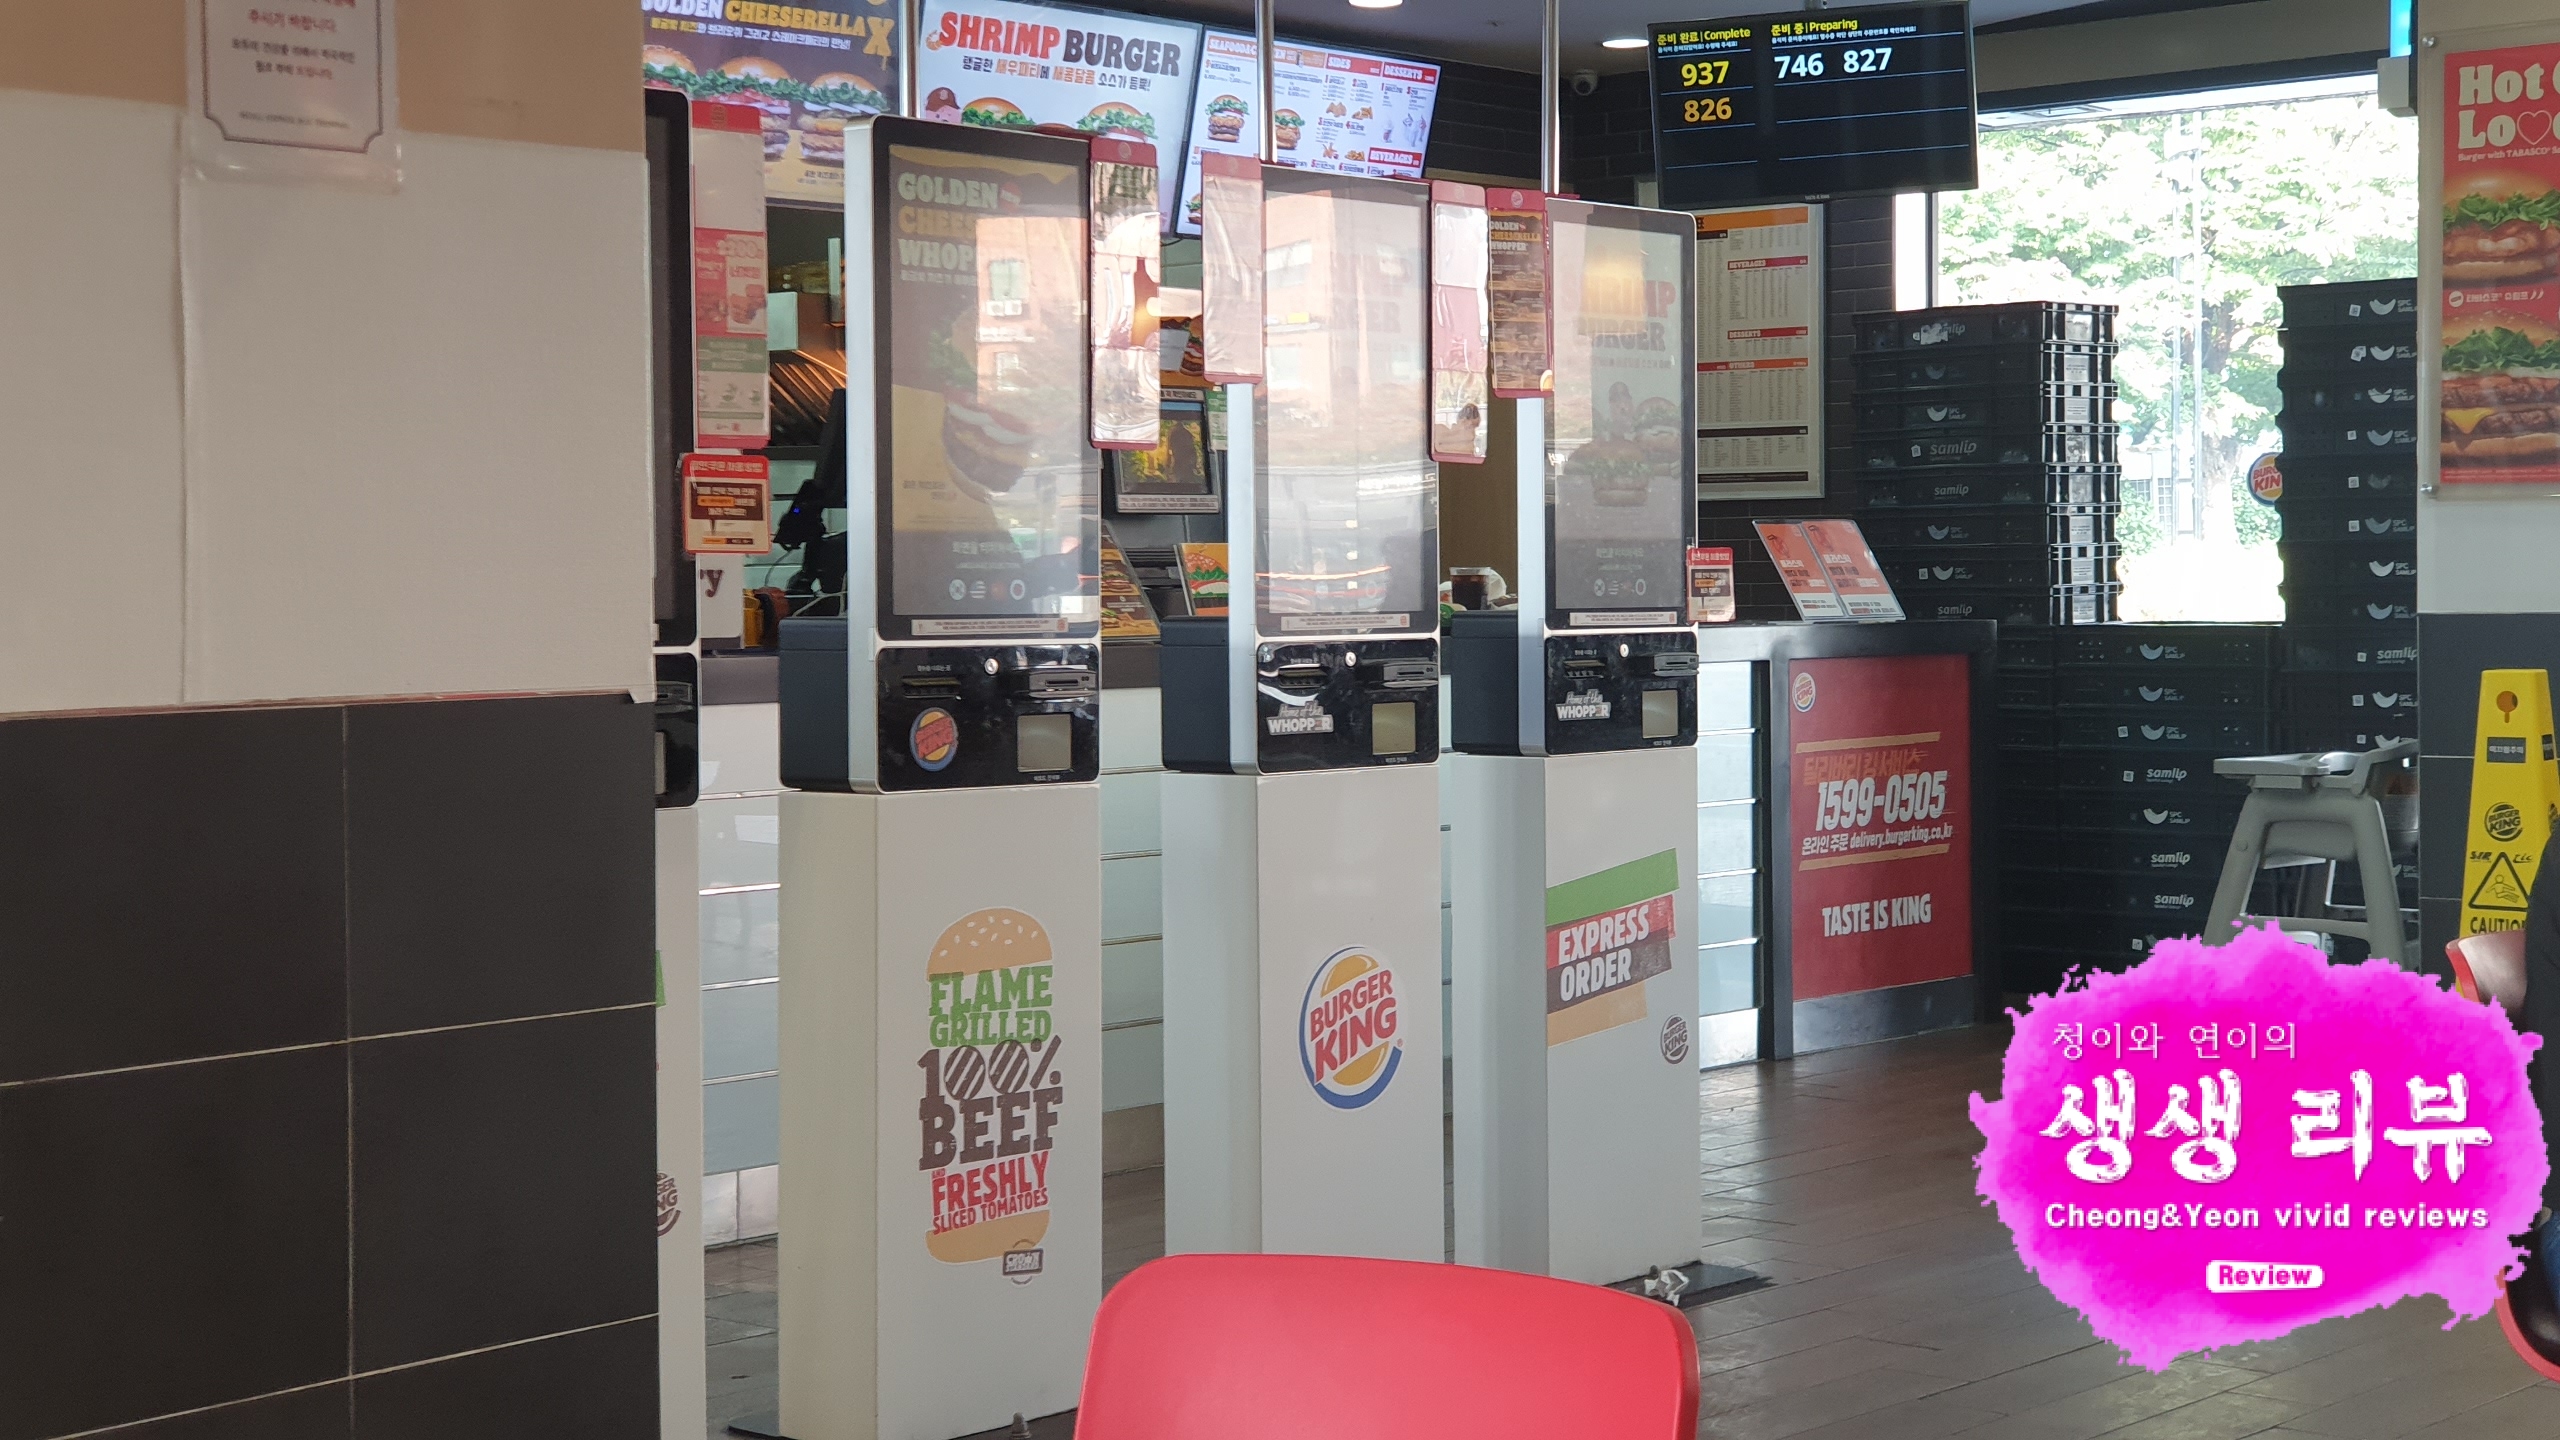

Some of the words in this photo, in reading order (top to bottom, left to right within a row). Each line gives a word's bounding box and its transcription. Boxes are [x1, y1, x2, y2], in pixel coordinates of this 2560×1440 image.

[725, 1, 866, 37] CHEESERELLA
[863, 17, 895, 56] X
[1657, 33, 1677, 46] 준비
[1679, 31, 1700, 45] 완료
[1704, 28, 1751, 41] Complete
[1771, 24, 1790, 36] 준비
[1793, 22, 1804, 34] 중
[1809, 19, 1858, 33] Preparing
[939, 11, 1061, 60] SHRIMP
[1063, 29, 1183, 77] BURGER
[995, 58, 1050, 80] 새우패티에
[1052, 65, 1095, 85] 새콤달콤
[1097, 73, 1127, 89] 소스가
[1680, 60, 1730, 87] 937
[1774, 53, 1825, 79] 746
[1843, 47, 1893, 75] 827
[2458, 62, 2545, 106] Hot
[1684, 97, 1732, 123] 826
[2458, 152, 2486, 163] Burger
[2487, 151, 2505, 160] with
[897, 172, 998, 209] GOLDEN
[898, 239, 977, 271] WHOP
[1729, 259, 1766, 270] BEVERAGES
[1729, 329, 1761, 339] DESSERTS
[1729, 361, 1755, 370] OTHERS
[1930, 439, 1977, 456] samlip
[1934, 484, 1969, 497] samlip
[2254, 475, 2282, 493] KIN
[2377, 646, 2417, 661] samlip
[1796, 685, 1813, 702] KING
[1268, 717, 1332, 733] WHOPPER
[1557, 705, 1610, 719] WHOPPER
[2146, 768, 2187, 781] samlip
[1816, 770, 1948, 831] 1599-0505
[2488, 809, 2520, 825] BURGER
[2489, 817, 2522, 834] KING
[1802, 835, 1829, 856] 온라인
[1830, 832, 1849, 852] 주문
[1850, 823, 1953, 850] delivery.burgerking.co.kr
[2151, 852, 2190, 866] samlip
[2154, 894, 2194, 908] samlip
[1822, 901, 1870, 937] TASTE
[1873, 899, 1888, 930] IS
[1891, 893, 1931, 928] KING
[2470, 917, 2525, 935] CAUTIO
[1559, 904, 1649, 965] EXPRESS
[1560, 948, 1632, 1001] ORDER
[929, 966, 1053, 1016] FLAME
[1310, 969, 1393, 1042] BURGER
[930, 1010, 1052, 1048] GRILLED
[1315, 997, 1397, 1083] KING
[1663, 1021, 1687, 1043] BURGER
[1664, 1030, 1688, 1056] KING
[917, 1035, 1062, 1101] 100%
[919, 1086, 1063, 1170] BEEF
[933, 1151, 1049, 1217] FRESHLY
[933, 1207, 976, 1235] SLICED
[980, 1187, 1048, 1221] TOMATOES
